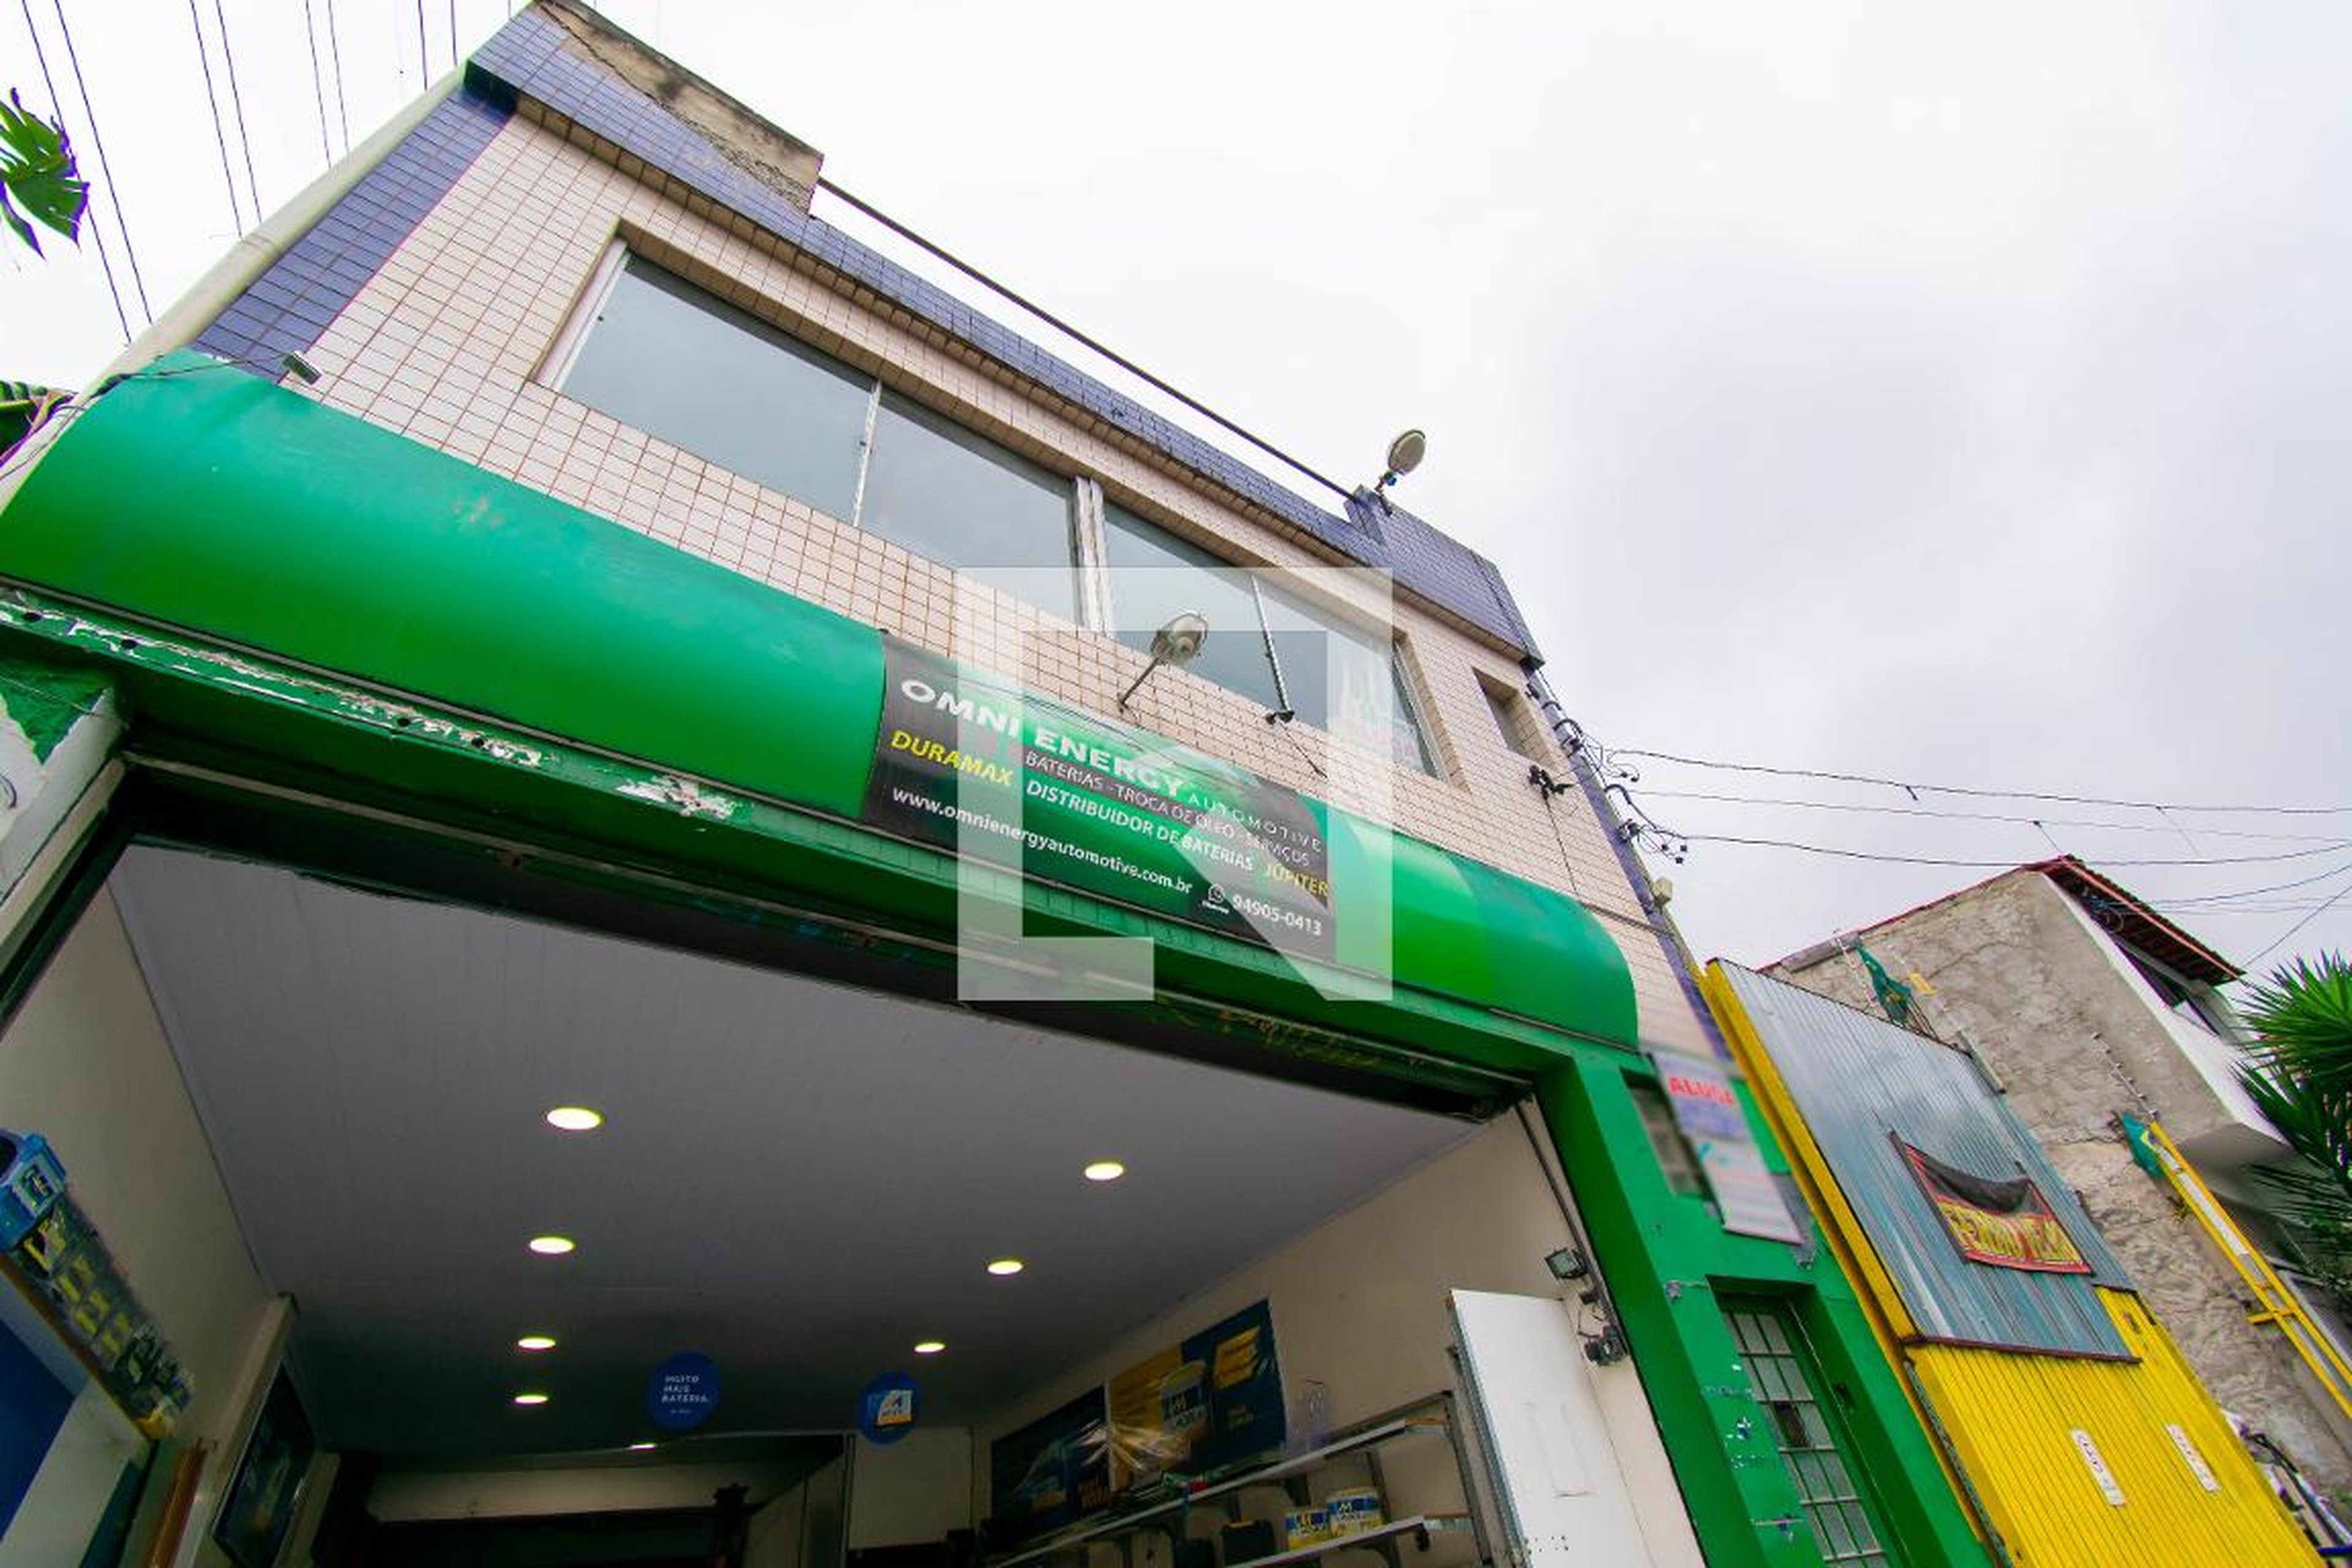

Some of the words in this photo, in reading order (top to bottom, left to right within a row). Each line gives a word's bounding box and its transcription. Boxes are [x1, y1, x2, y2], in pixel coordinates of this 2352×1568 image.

[891, 729, 1014, 786] DURAMAX
[900, 679, 1020, 737] OMNI
[1035, 728, 1185, 797] ENERGY
[1189, 793, 1322, 853] AUTOMOTIVE
[1025, 750, 1103, 790] BATERIAS
[1170, 804, 1192, 824] DE
[892, 786, 1193, 894] www.omnienergyautomotive.com.br
[1027, 780, 1154, 839] DISTRIBUIDOR
[1156, 825, 1180, 845] DE
[1182, 835, 1253, 871] BATERIAS
[1232, 895, 1322, 937] 94905-0413
